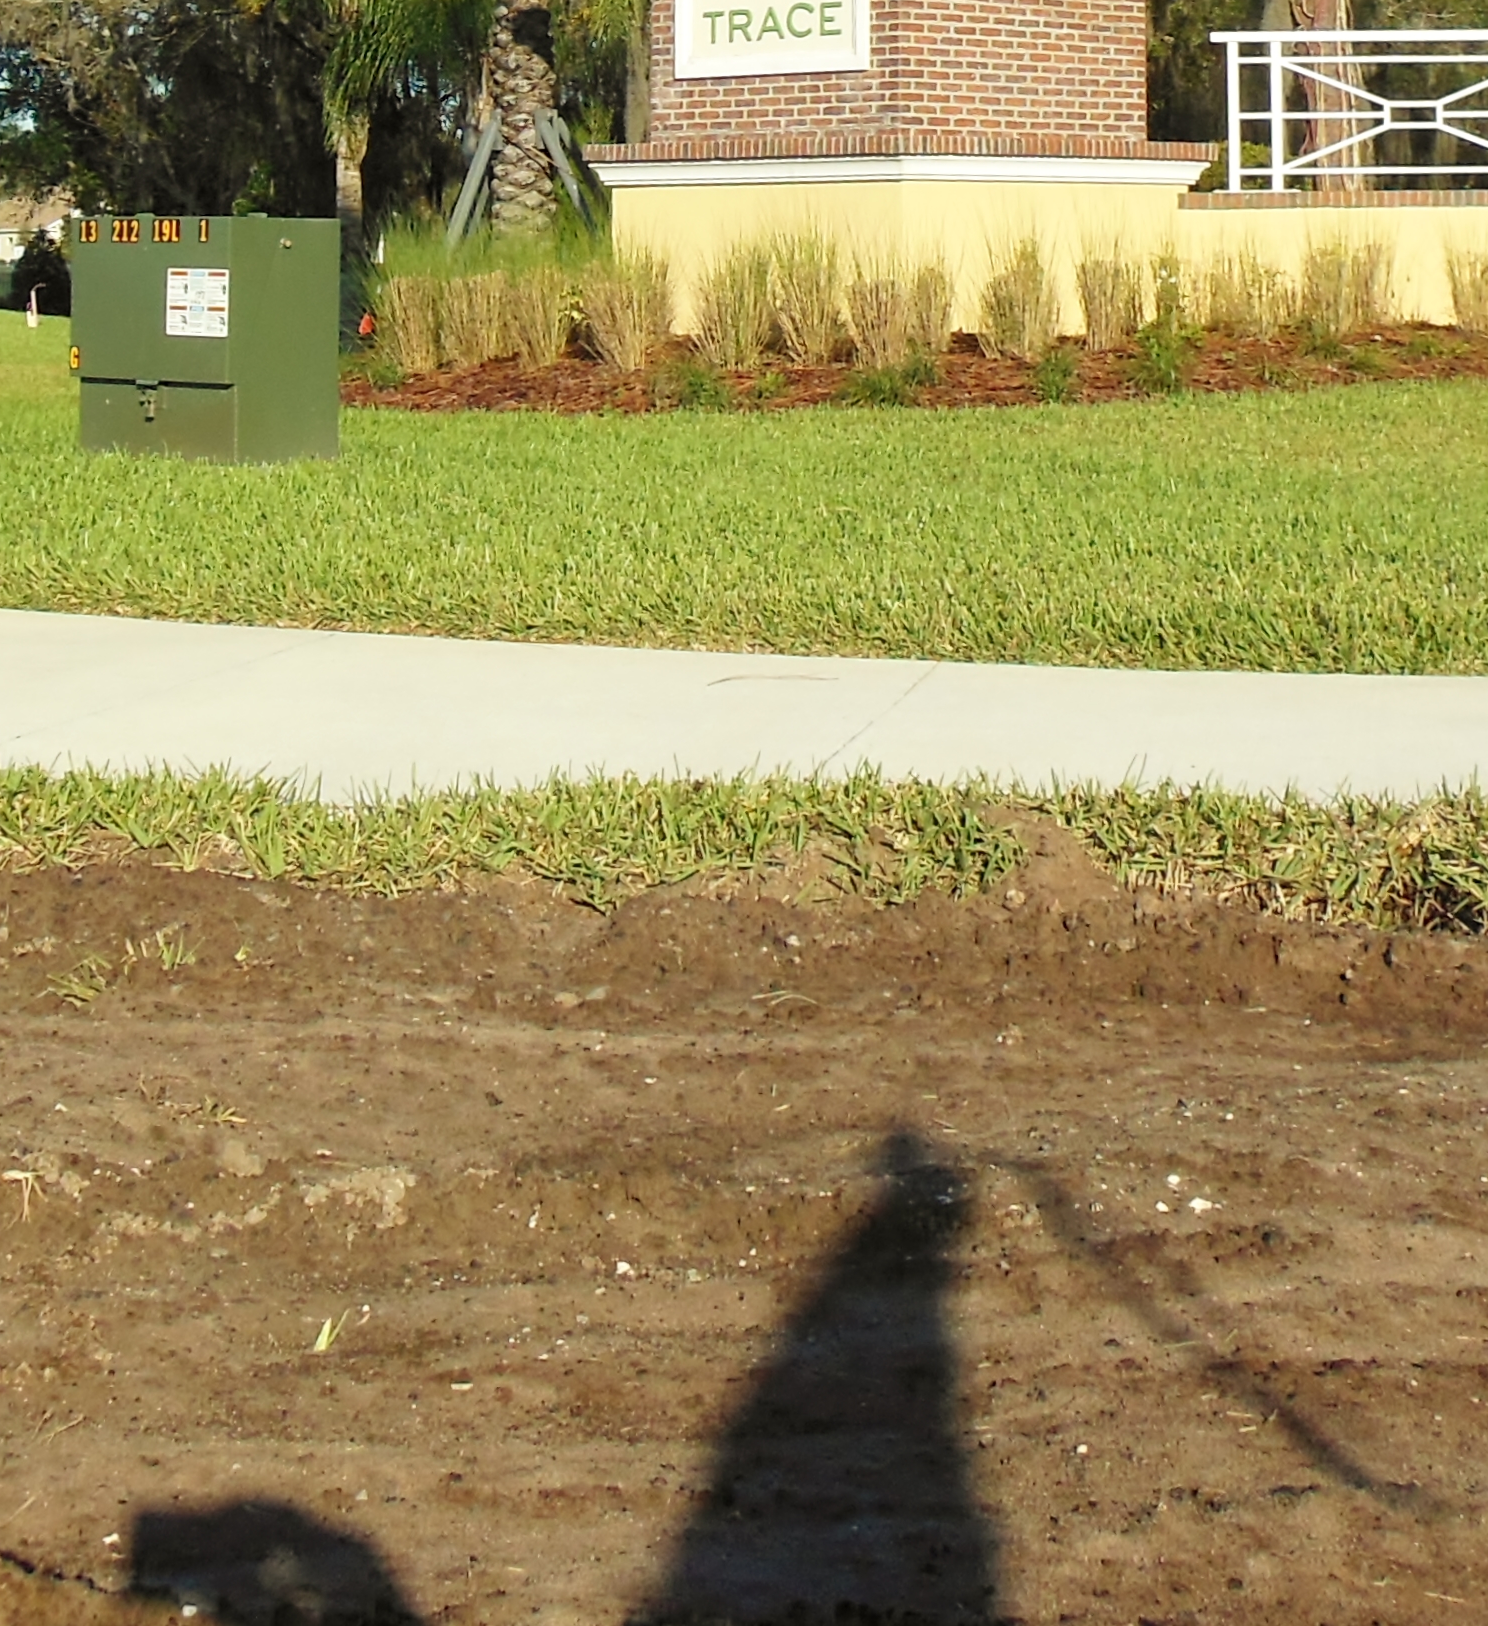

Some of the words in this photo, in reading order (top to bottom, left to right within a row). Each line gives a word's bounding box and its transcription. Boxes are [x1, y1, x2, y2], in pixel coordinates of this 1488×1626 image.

[702, 1, 843, 45] TRACE
[80, 219, 98, 242] 13
[112, 219, 139, 242] 212
[153, 219, 180, 242] 19L
[199, 219, 209, 242] 1
[70, 346, 80, 369] G
